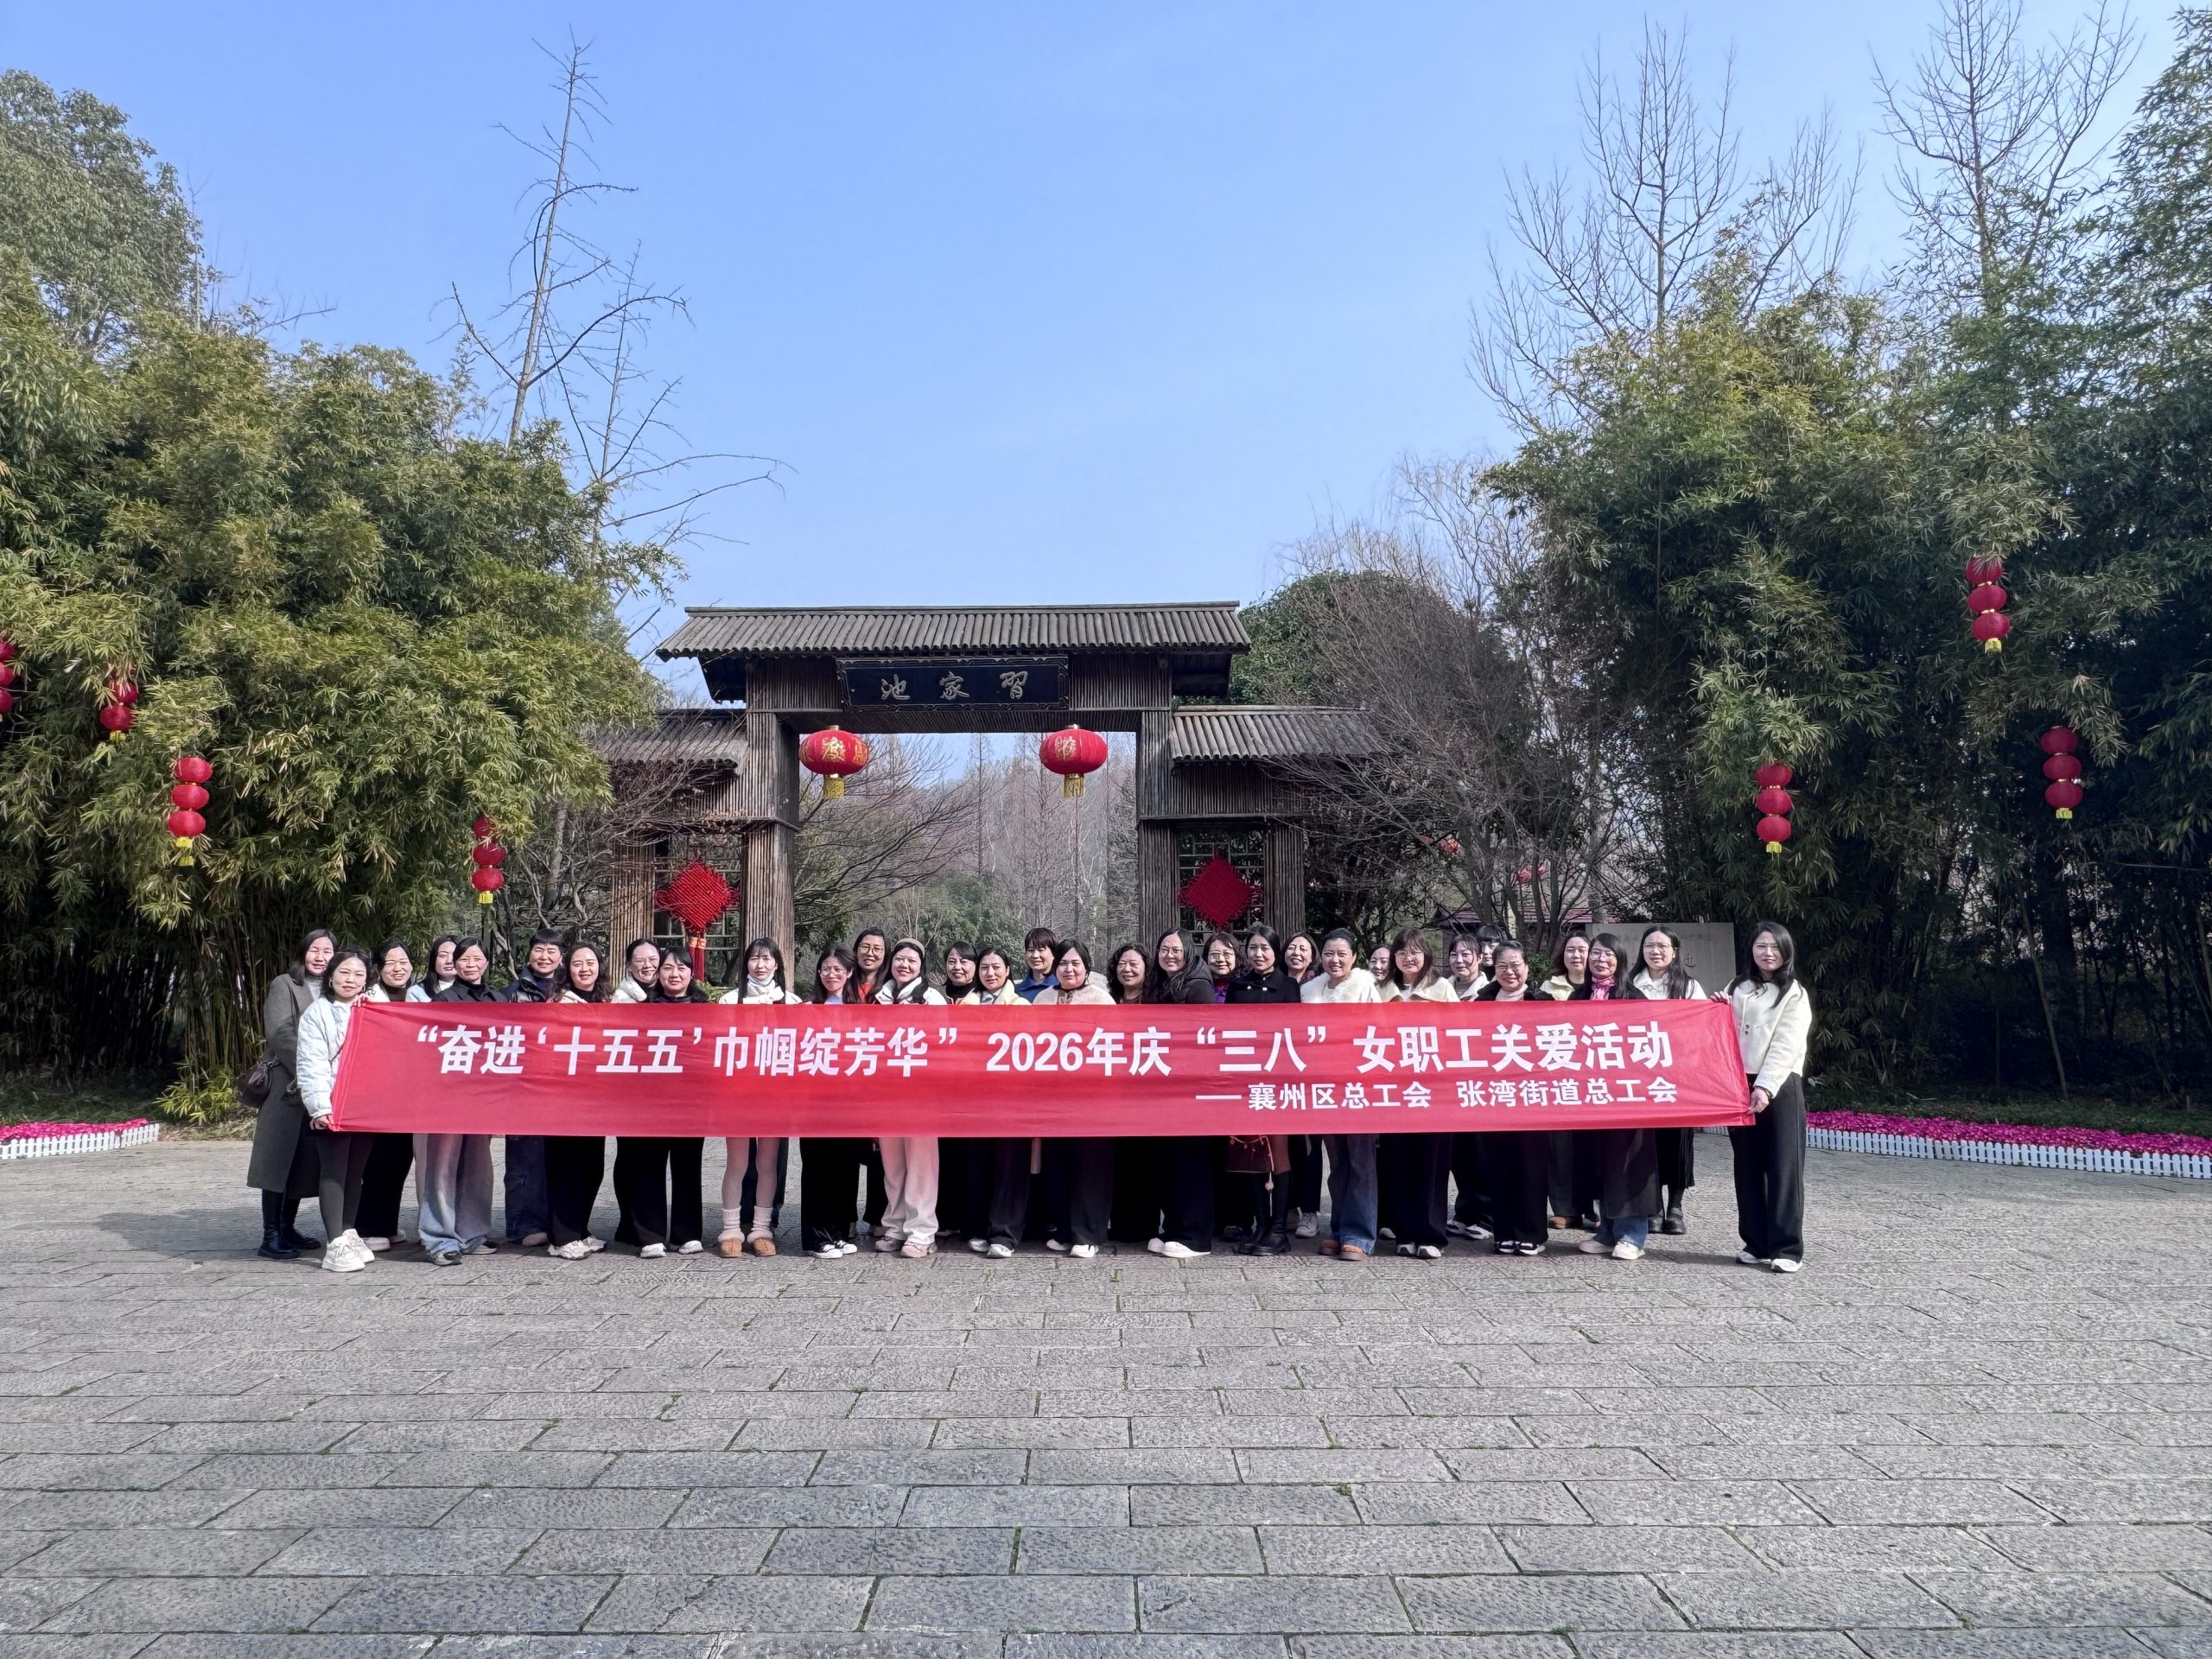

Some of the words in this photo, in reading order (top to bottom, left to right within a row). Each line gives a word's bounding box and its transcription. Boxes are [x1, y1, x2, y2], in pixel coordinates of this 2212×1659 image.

[1455, 1075, 1679, 1109] 张湾街道总工会
